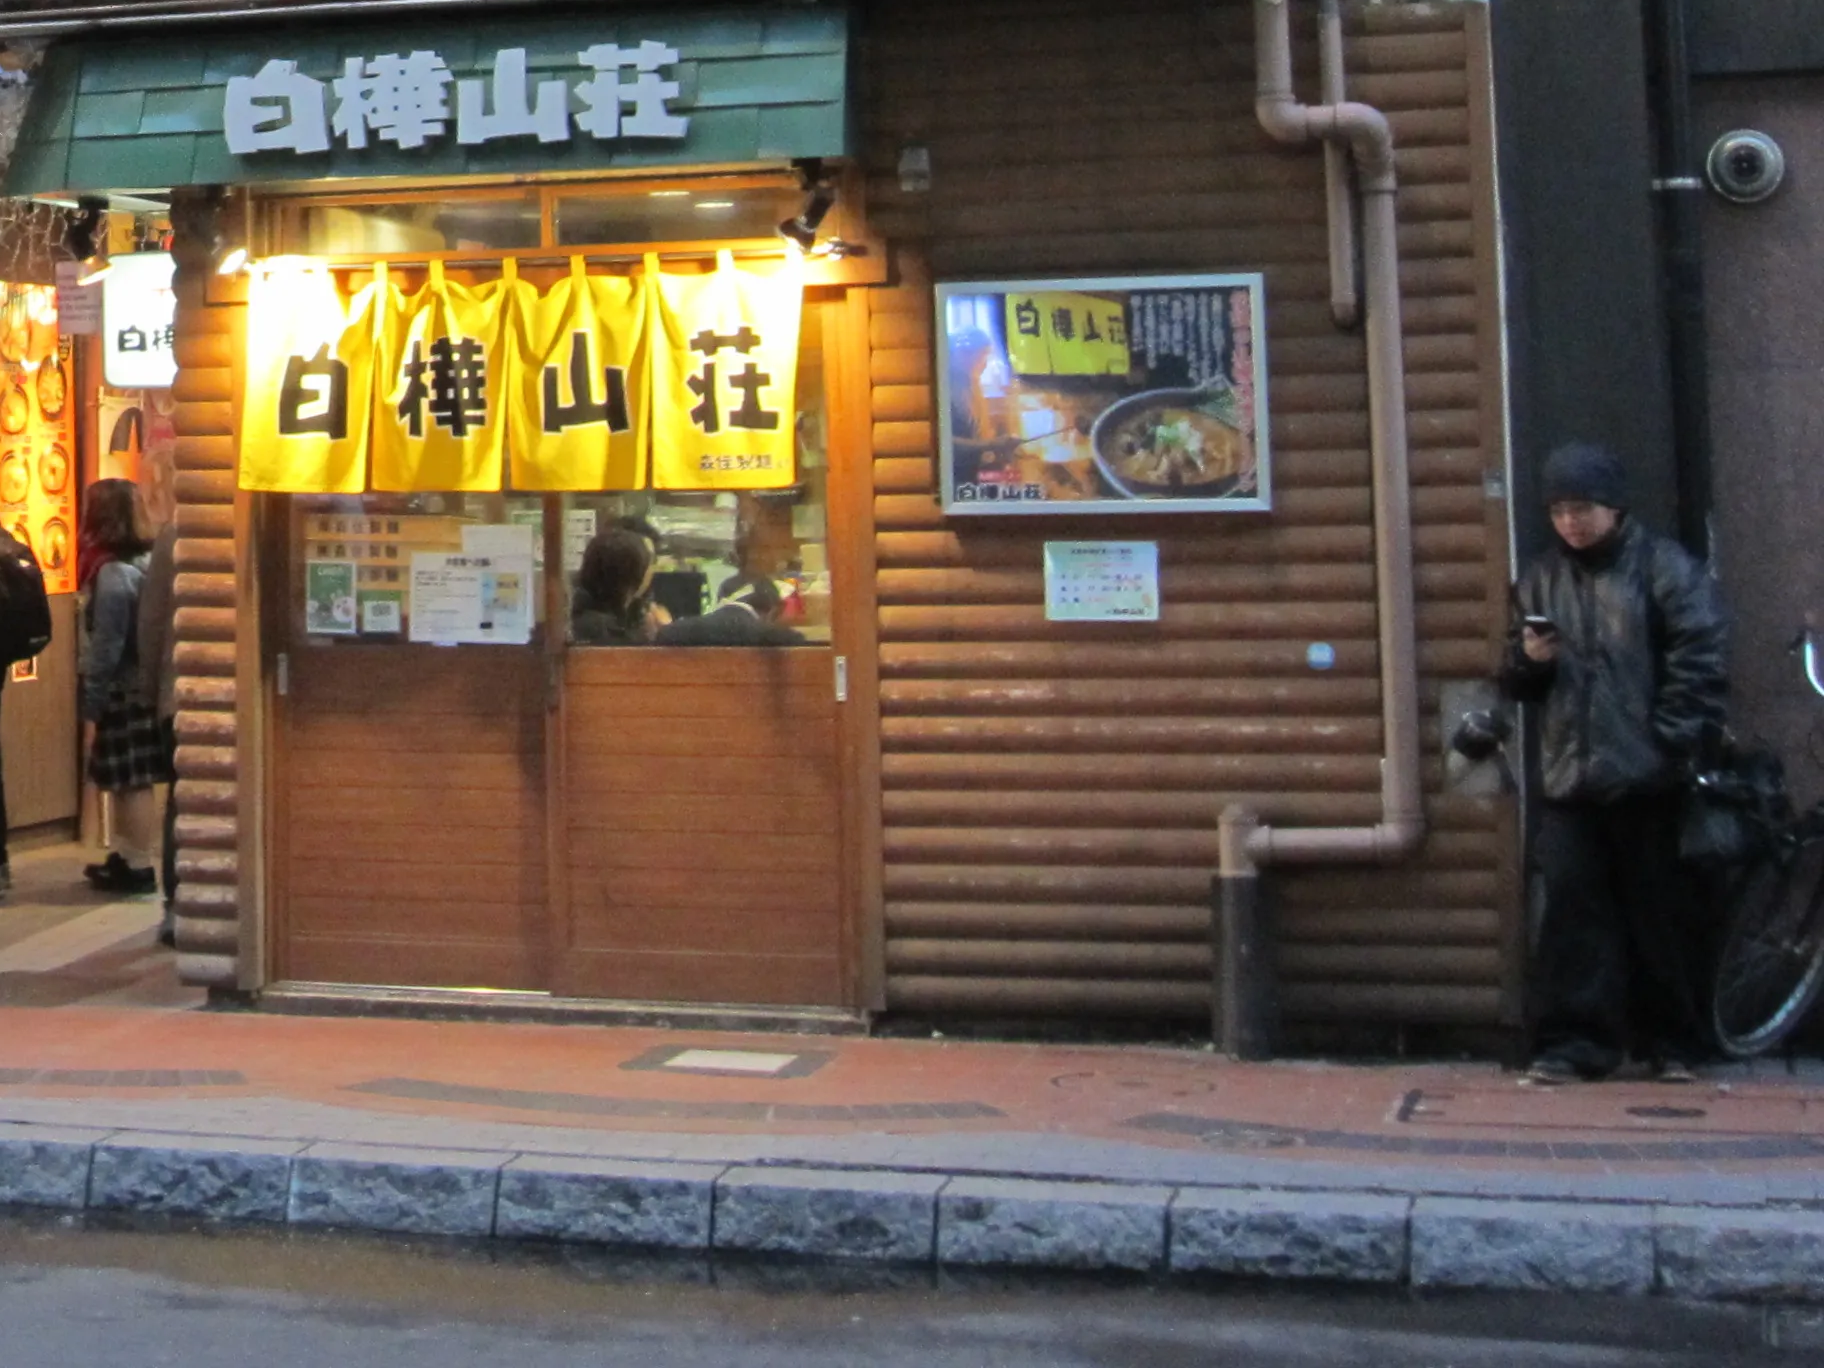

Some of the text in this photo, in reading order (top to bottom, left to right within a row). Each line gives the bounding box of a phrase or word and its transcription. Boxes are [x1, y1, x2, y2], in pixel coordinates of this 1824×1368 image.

[223, 38, 691, 156] 白樺山荘
[277, 324, 781, 441] 白樺山荘
